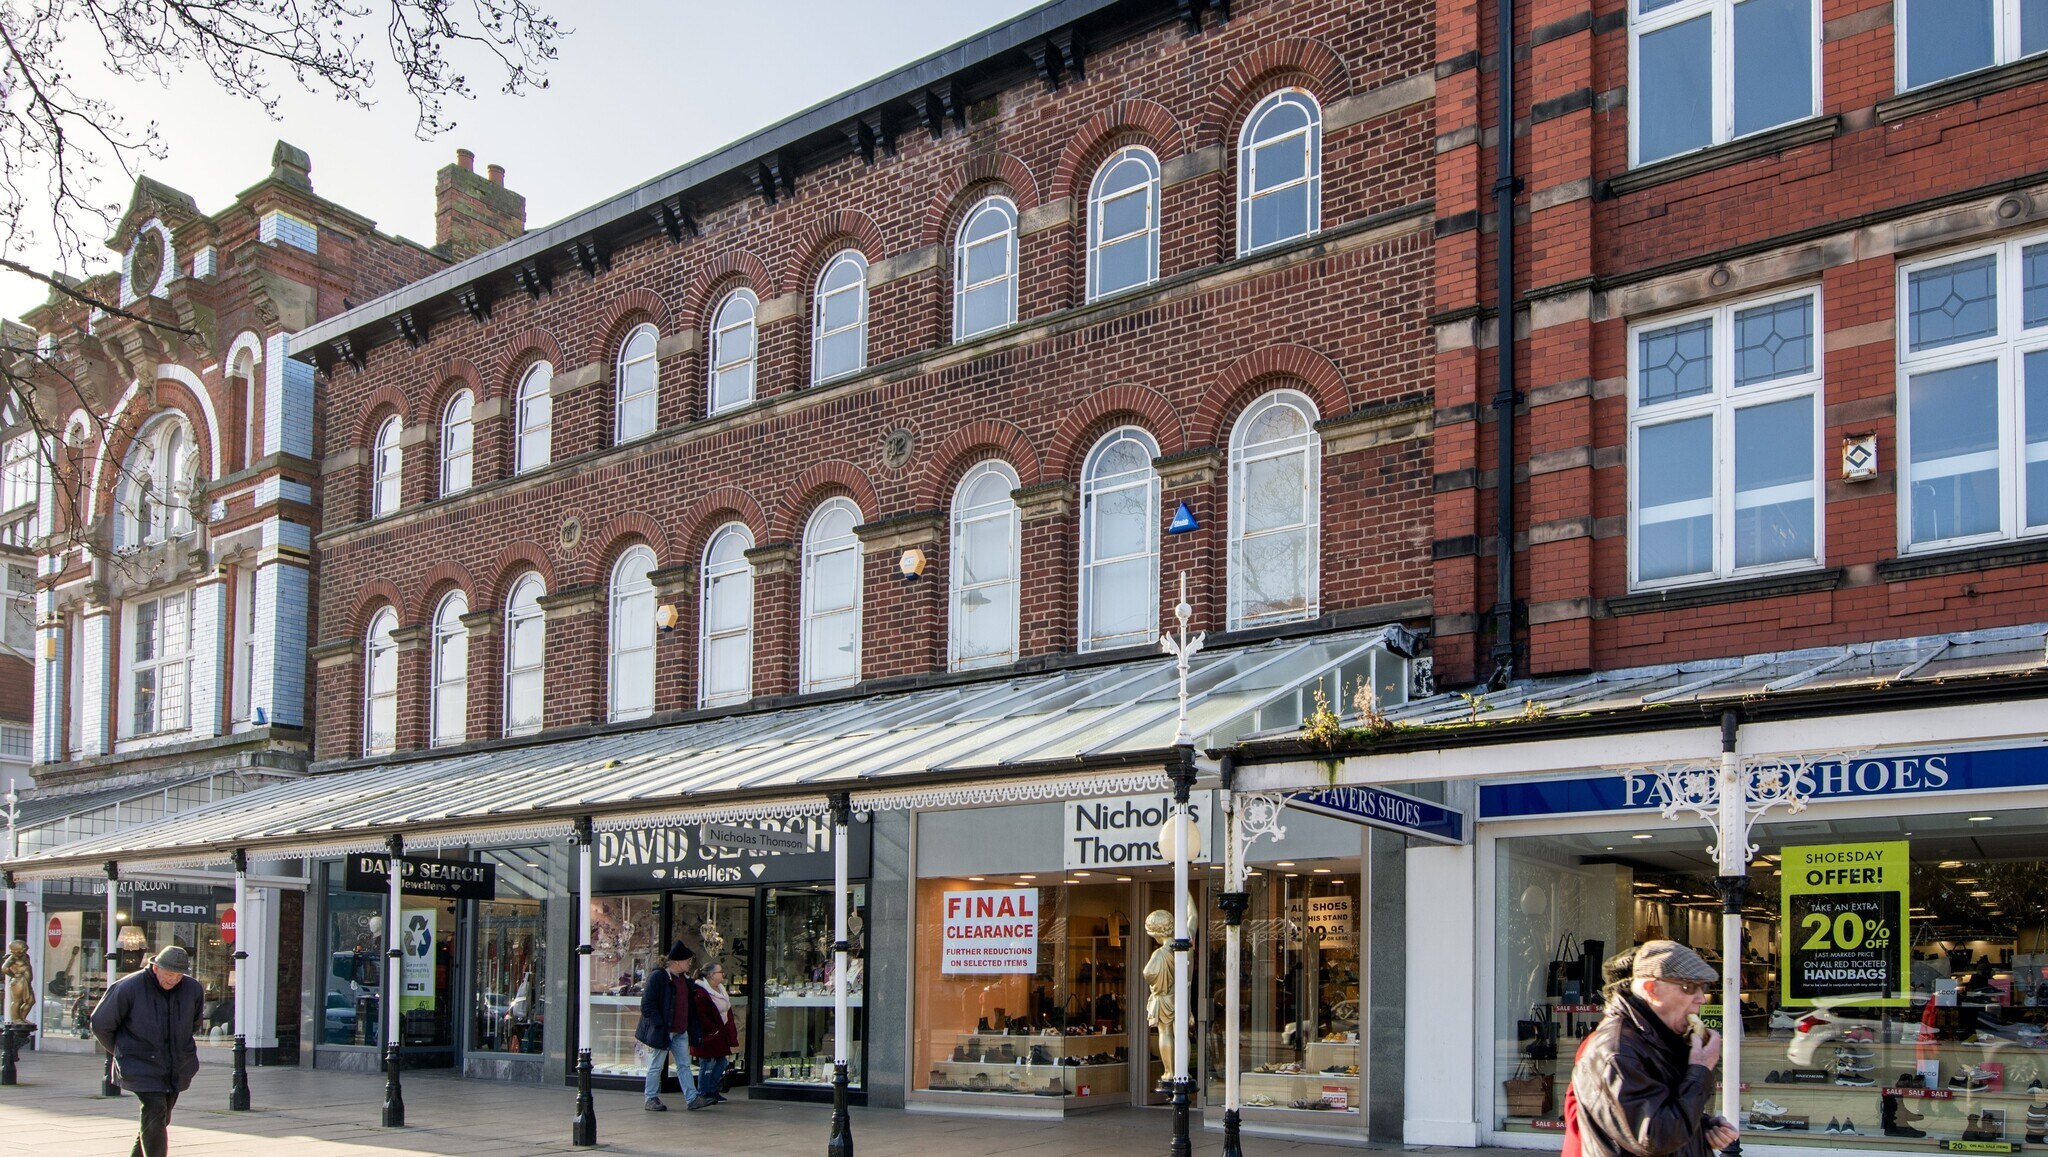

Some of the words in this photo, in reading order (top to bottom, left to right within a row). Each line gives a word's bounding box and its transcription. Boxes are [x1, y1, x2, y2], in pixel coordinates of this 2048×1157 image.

[1796, 756, 1949, 795] SHOES
[1076, 798, 1199, 831] Nichols
[1379, 797, 1420, 826] SHOES
[598, 826, 689, 867] DAVID
[710, 829, 757, 844] Nicholas
[760, 834, 803, 849] Thomson
[1073, 836, 1200, 864] Thoms
[1805, 850, 1884, 864] SHOESDAY
[420, 863, 484, 882] SEARCH
[1805, 866, 1883, 886] OFFER!
[141, 900, 207, 915] Rohan
[948, 895, 1034, 919] FINAL
[1312, 901, 1348, 911] SHOES
[1811, 904, 1831, 912] TAKE
[1834, 903, 1849, 911] AN
[1851, 902, 1879, 911] EXTRA
[48, 928, 62, 936] SALES
[946, 924, 1033, 939] CLEARANCE
[1800, 912, 1890, 950] 20%
[983, 947, 1033, 955] REDUCTIONS
[1865, 939, 1889, 949] OFF
[1851, 960, 1887, 968] TICKETED
[1804, 969, 1887, 980] HANDBAGS
